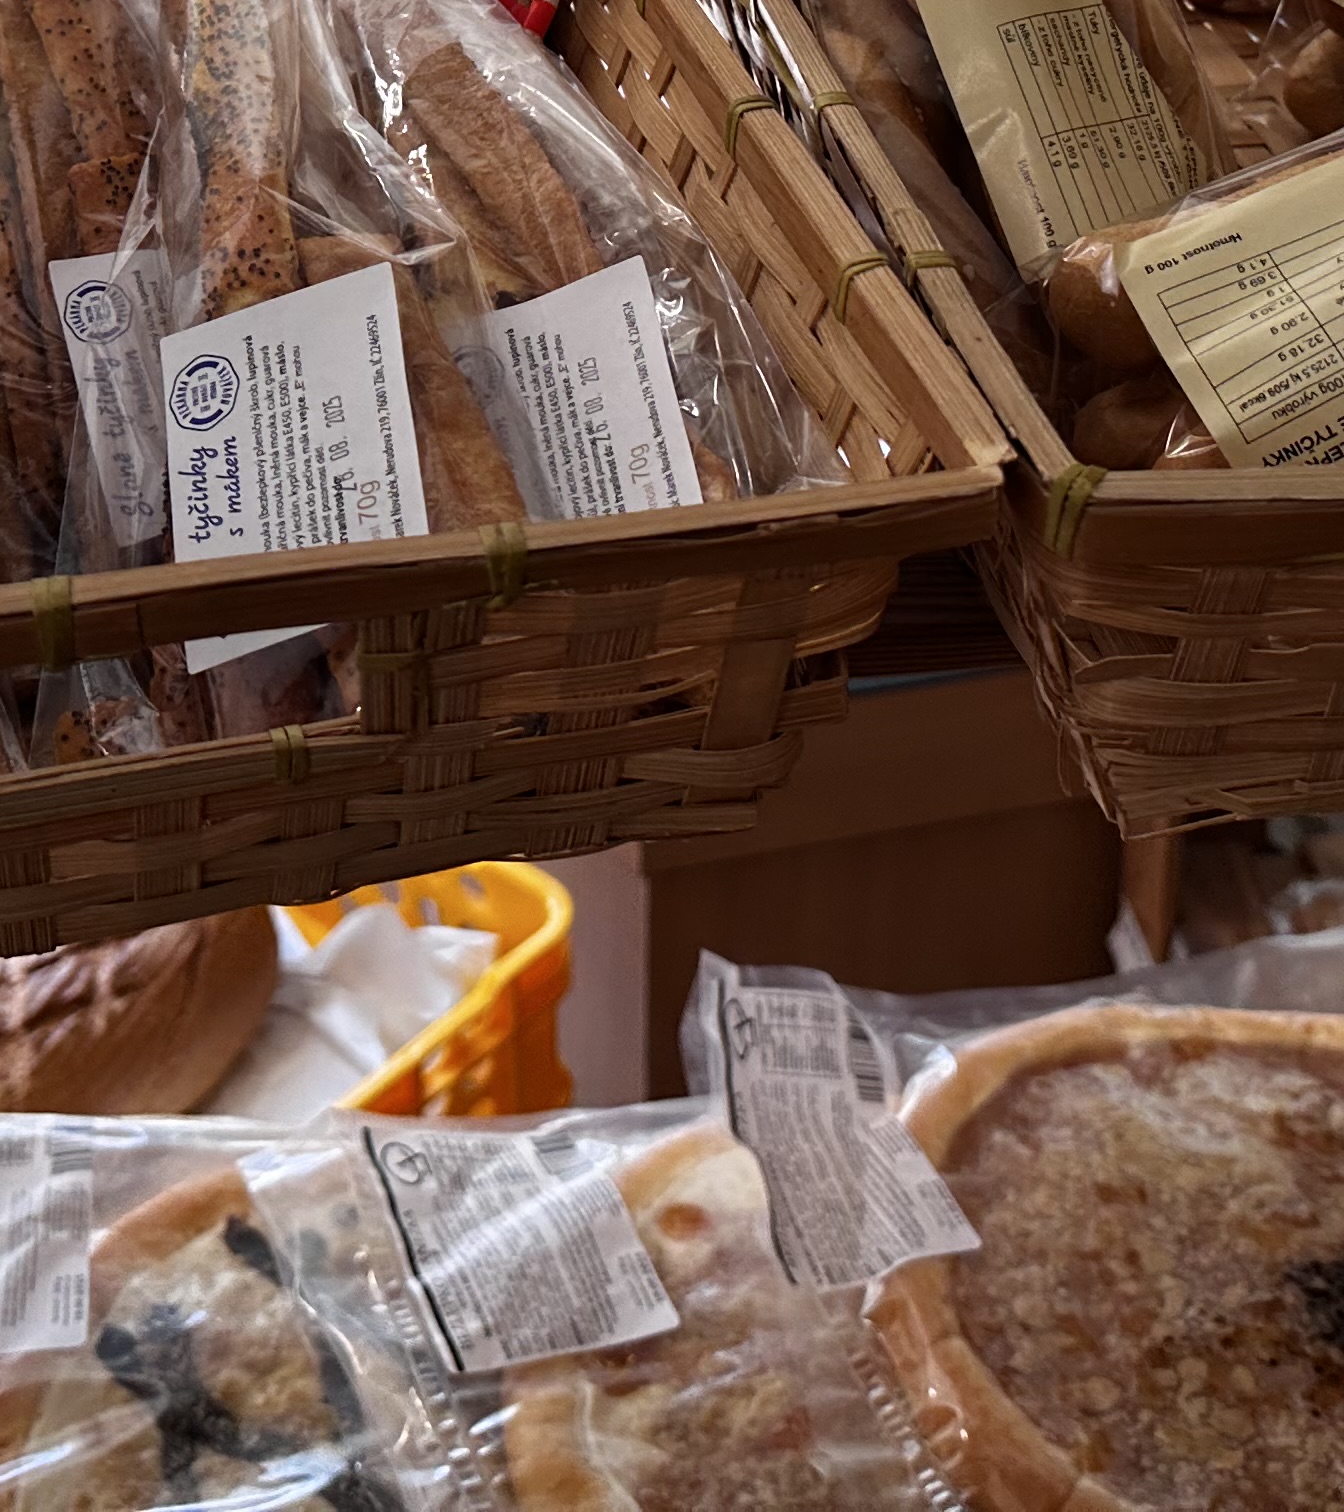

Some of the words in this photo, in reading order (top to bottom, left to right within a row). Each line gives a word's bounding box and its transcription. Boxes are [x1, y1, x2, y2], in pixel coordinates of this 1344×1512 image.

[1155, 254, 1181, 274] 100
[1179, 227, 1242, 267] Hmotnost
[575, 356, 600, 386] 2025
[321, 394, 346, 428] 2025
[1267, 385, 1320, 421] výrobku
[624, 442, 654, 485] 70g
[1257, 421, 1338, 473] TYČINKY
[175, 445, 224, 544] tyčinky
[213, 435, 242, 514] mákem
[354, 479, 383, 524] 70g
[228, 526, 244, 537] s
